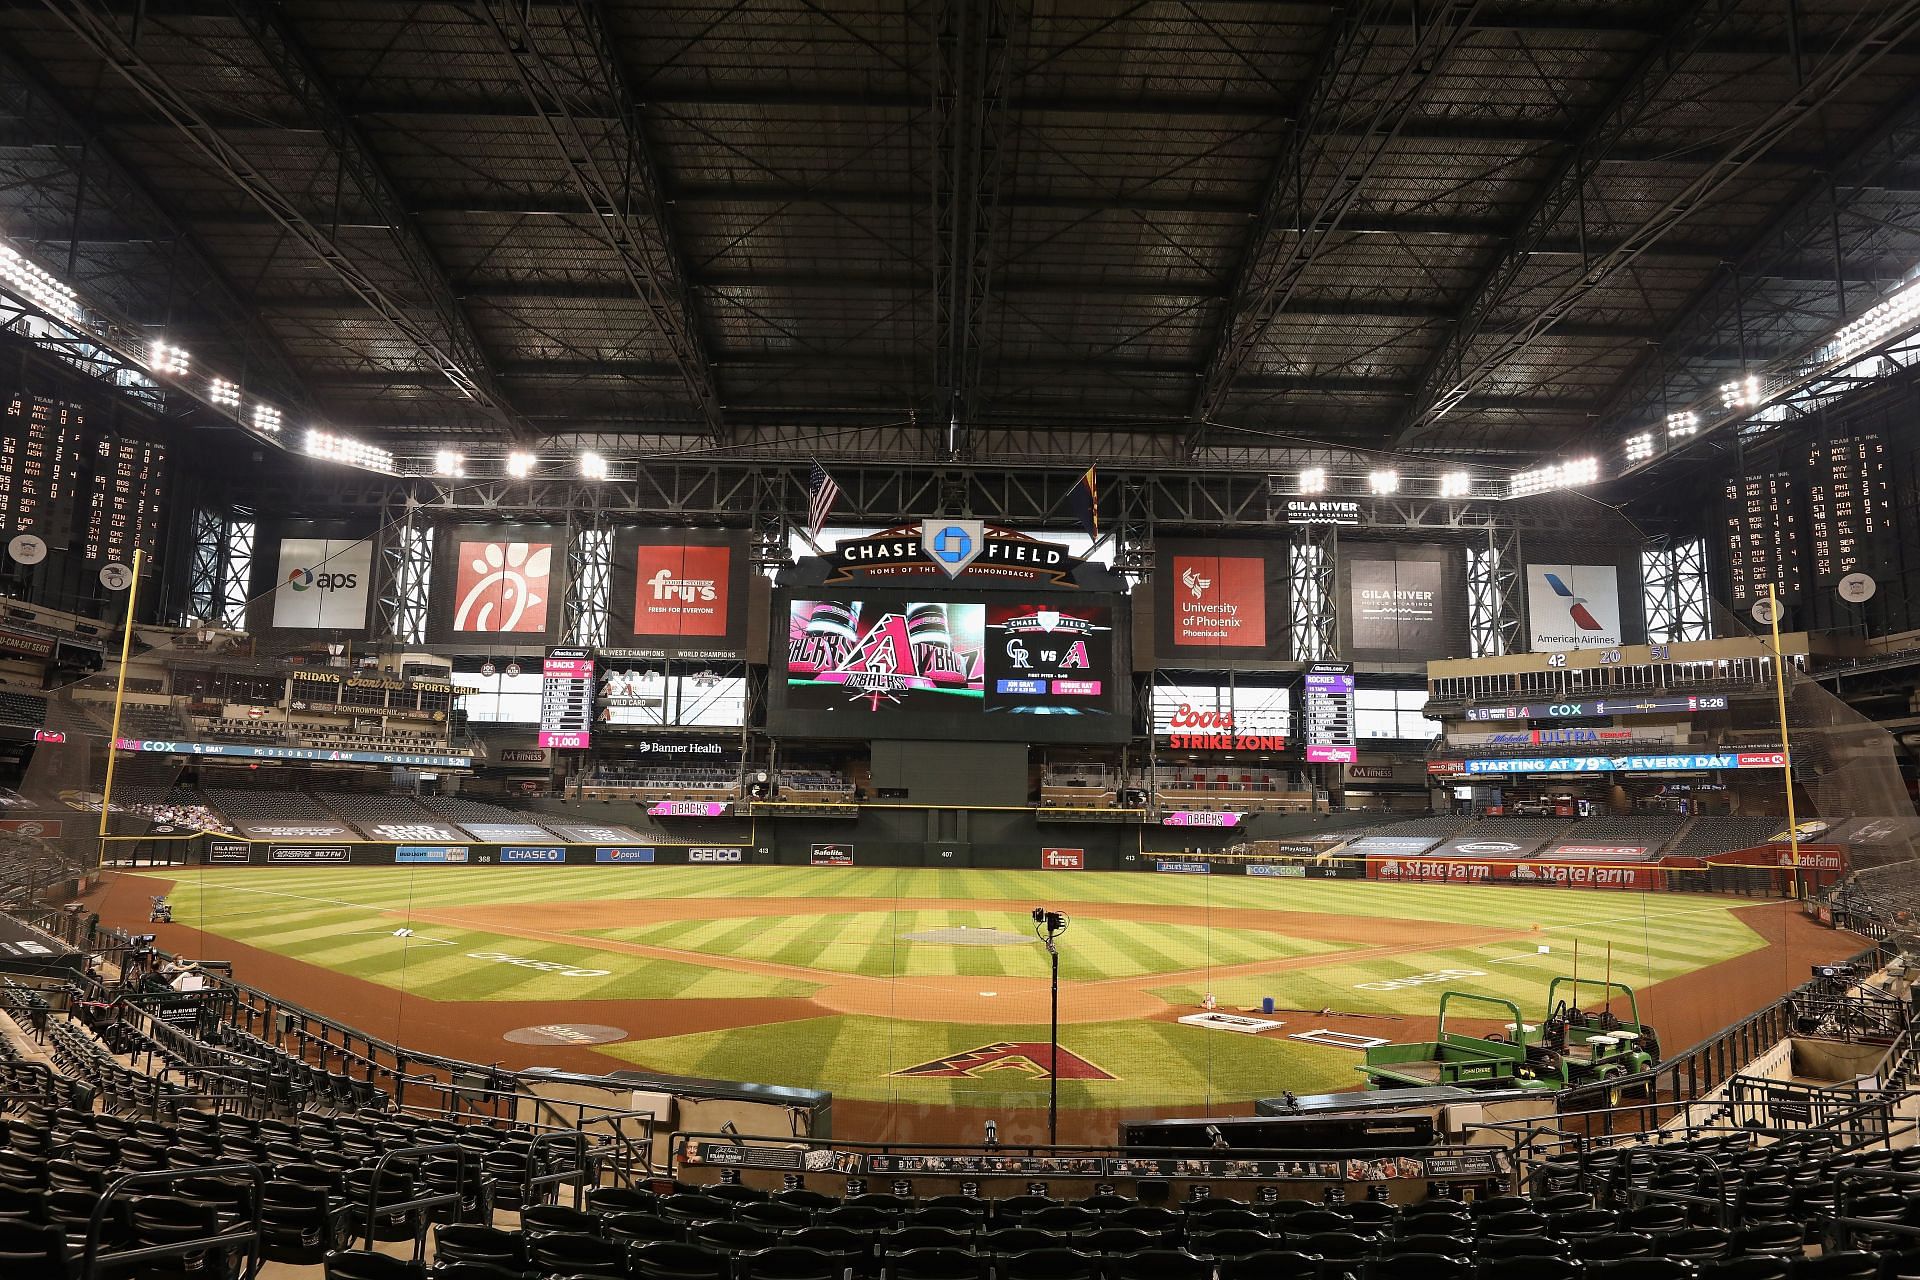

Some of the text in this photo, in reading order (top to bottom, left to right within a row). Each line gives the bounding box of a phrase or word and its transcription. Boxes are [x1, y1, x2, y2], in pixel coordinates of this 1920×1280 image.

[12, 400, 21, 408] 19
[8, 408, 46, 420] 54 ATL
[4, 437, 16, 445] 27
[3, 445, 15, 453] 36
[1, 456, 13, 464] 57
[1288, 502, 1358, 512] GILA RIVER
[844, 542, 1060, 564] CHASE FIELD
[870, 567, 895, 575] HOME
[968, 567, 1034, 578] DIAMONDBACKS
[317, 573, 357, 592] aps
[648, 569, 715, 603] fry's
[1362, 590, 1432, 600] GILA RIVER
[1183, 602, 1237, 615] University
[1183, 616, 1240, 626] of Phoenix
[1581, 636, 1615, 644] Airlines
[32, 642, 50, 653] SEATS
[1041, 651, 1056, 661] VS
[1548, 646, 1670, 668] 42 20 51
[293, 671, 480, 695] FRIDAY'S Front Row SPORTS GRILL
[1549, 705, 1581, 715] COX
[1700, 699, 1724, 708] 5:26
[1170, 703, 1233, 728] Coors
[1542, 730, 1596, 741] ULTRA
[143, 741, 176, 752] COX
[548, 737, 580, 746] $1,000
[1170, 735, 1284, 750] STRIKE ZONE
[652, 743, 722, 753] Banner Health
[1470, 761, 1545, 771] STARTING
[1549, 761, 1569, 769] AT
[1632, 758, 1693, 768] EVERY
[1696, 757, 1732, 766] DAY
[679, 802, 708, 815] BACKS
[1194, 814, 1223, 826] BACKS
[690, 850, 741, 861] GEICO
[1047, 850, 1077, 867] fry's
[1816, 854, 1838, 867] Farm
[1405, 860, 1489, 878] State Farm
[1539, 864, 1634, 883] State Farm
